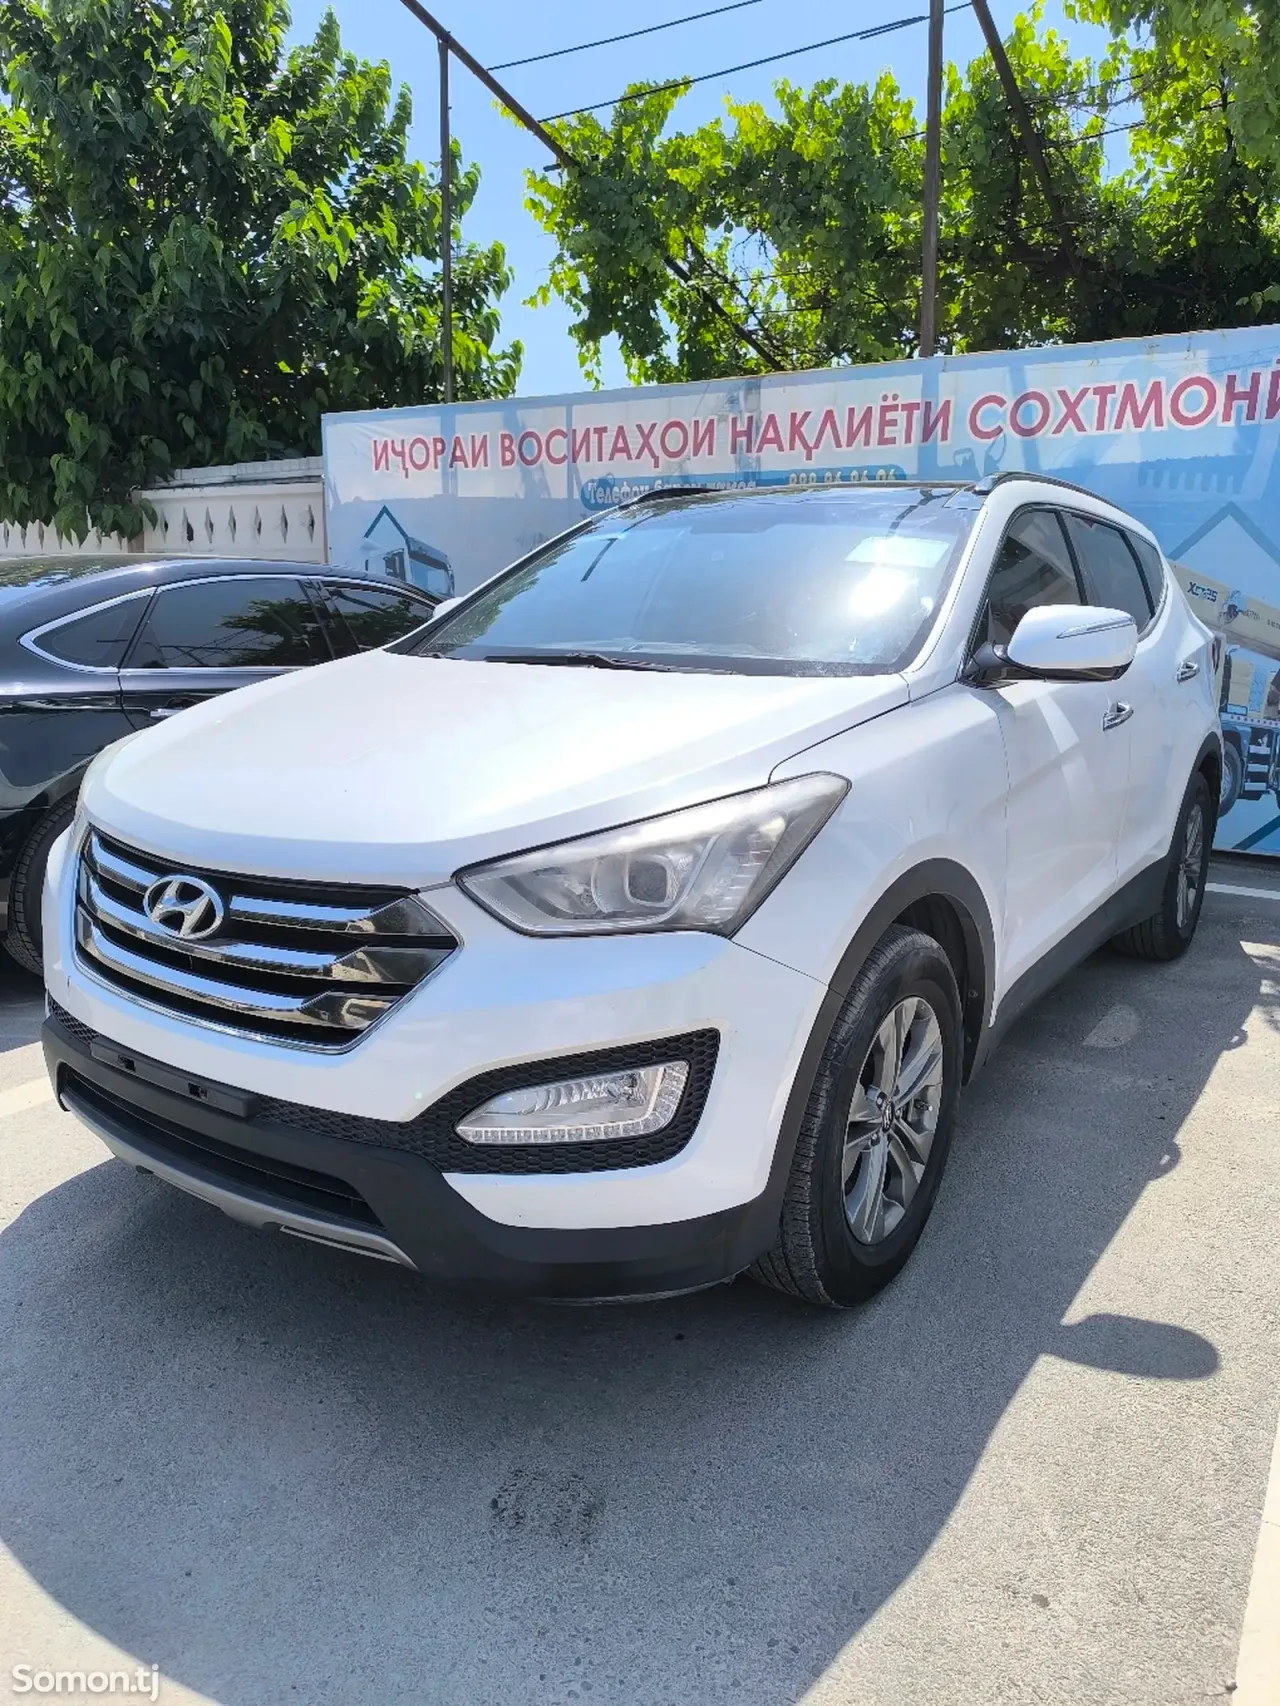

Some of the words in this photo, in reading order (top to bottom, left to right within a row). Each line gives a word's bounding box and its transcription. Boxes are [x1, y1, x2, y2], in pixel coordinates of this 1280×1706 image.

[373, 434, 489, 479] ИҶОРАИ
[500, 418, 715, 469] ВОСИТАҲОИ
[730, 393, 952, 461] НАҚЛИЁТИ
